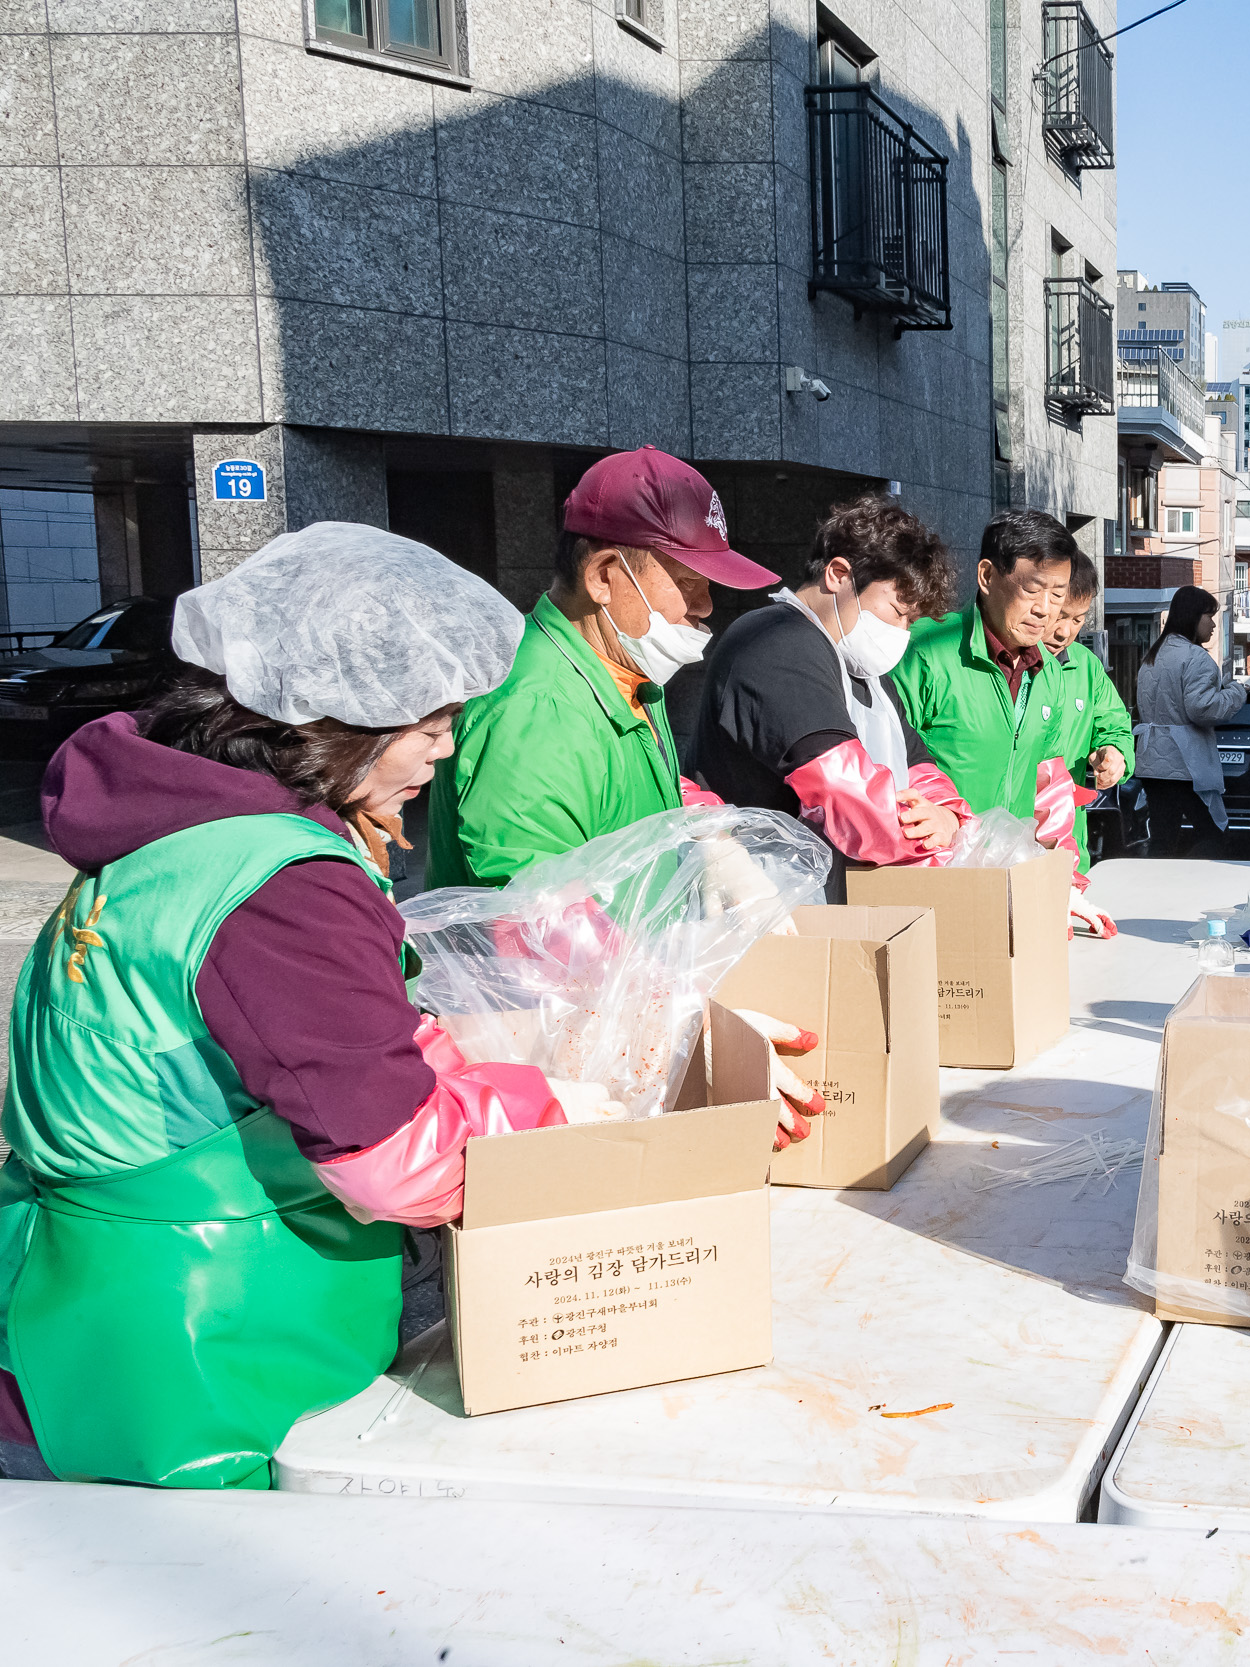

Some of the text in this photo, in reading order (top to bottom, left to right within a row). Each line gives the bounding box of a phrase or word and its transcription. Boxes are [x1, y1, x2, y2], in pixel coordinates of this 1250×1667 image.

[228, 479, 251, 497] 19
[1220, 753, 1242, 762] 9929
[821, 1080, 839, 1088] 보내기
[821, 1089, 855, 1105] 드리기
[550, 1237, 693, 1266] 2024년 광진구 따뜻한 겨울 보내기
[1204, 1249, 1222, 1258] 주관
[525, 1245, 717, 1289] 사랑의 김장 담가드리기
[1204, 1263, 1221, 1273] 후원
[603, 1286, 630, 1297] 12(화)
[649, 1277, 692, 1290] 11.13(수)
[518, 1316, 538, 1329] 주관
[565, 1298, 658, 1321] 광진구새마을부녀회
[519, 1333, 539, 1346] 후원
[566, 1323, 607, 1338] 광진구청
[519, 1351, 540, 1363] 협찬
[552, 1345, 584, 1357] 이마트
[587, 1337, 618, 1351] 자양점
